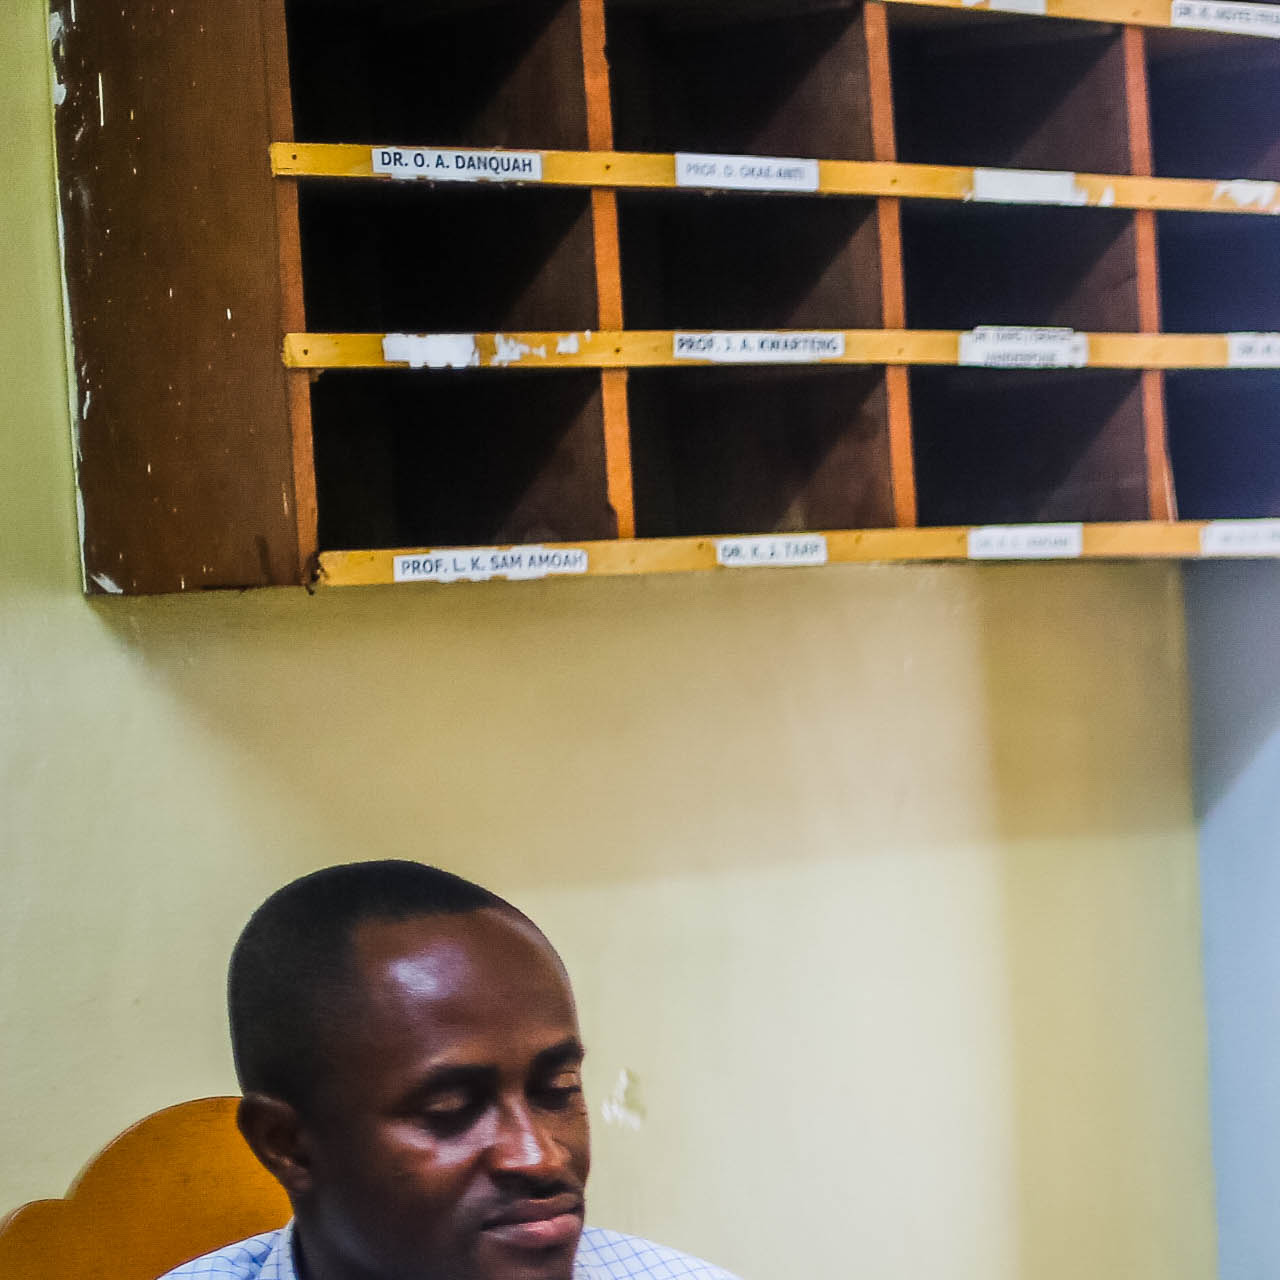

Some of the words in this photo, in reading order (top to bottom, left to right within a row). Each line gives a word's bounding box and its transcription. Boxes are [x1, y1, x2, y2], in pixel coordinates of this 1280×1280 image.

[381, 151, 408, 167] DR.
[413, 153, 430, 168] O.
[435, 154, 450, 169] A.
[455, 155, 533, 174] DANQUAH
[401, 558, 448, 576] PROF.
[490, 554, 523, 571] SAM
[528, 552, 584, 569] AMOAH
